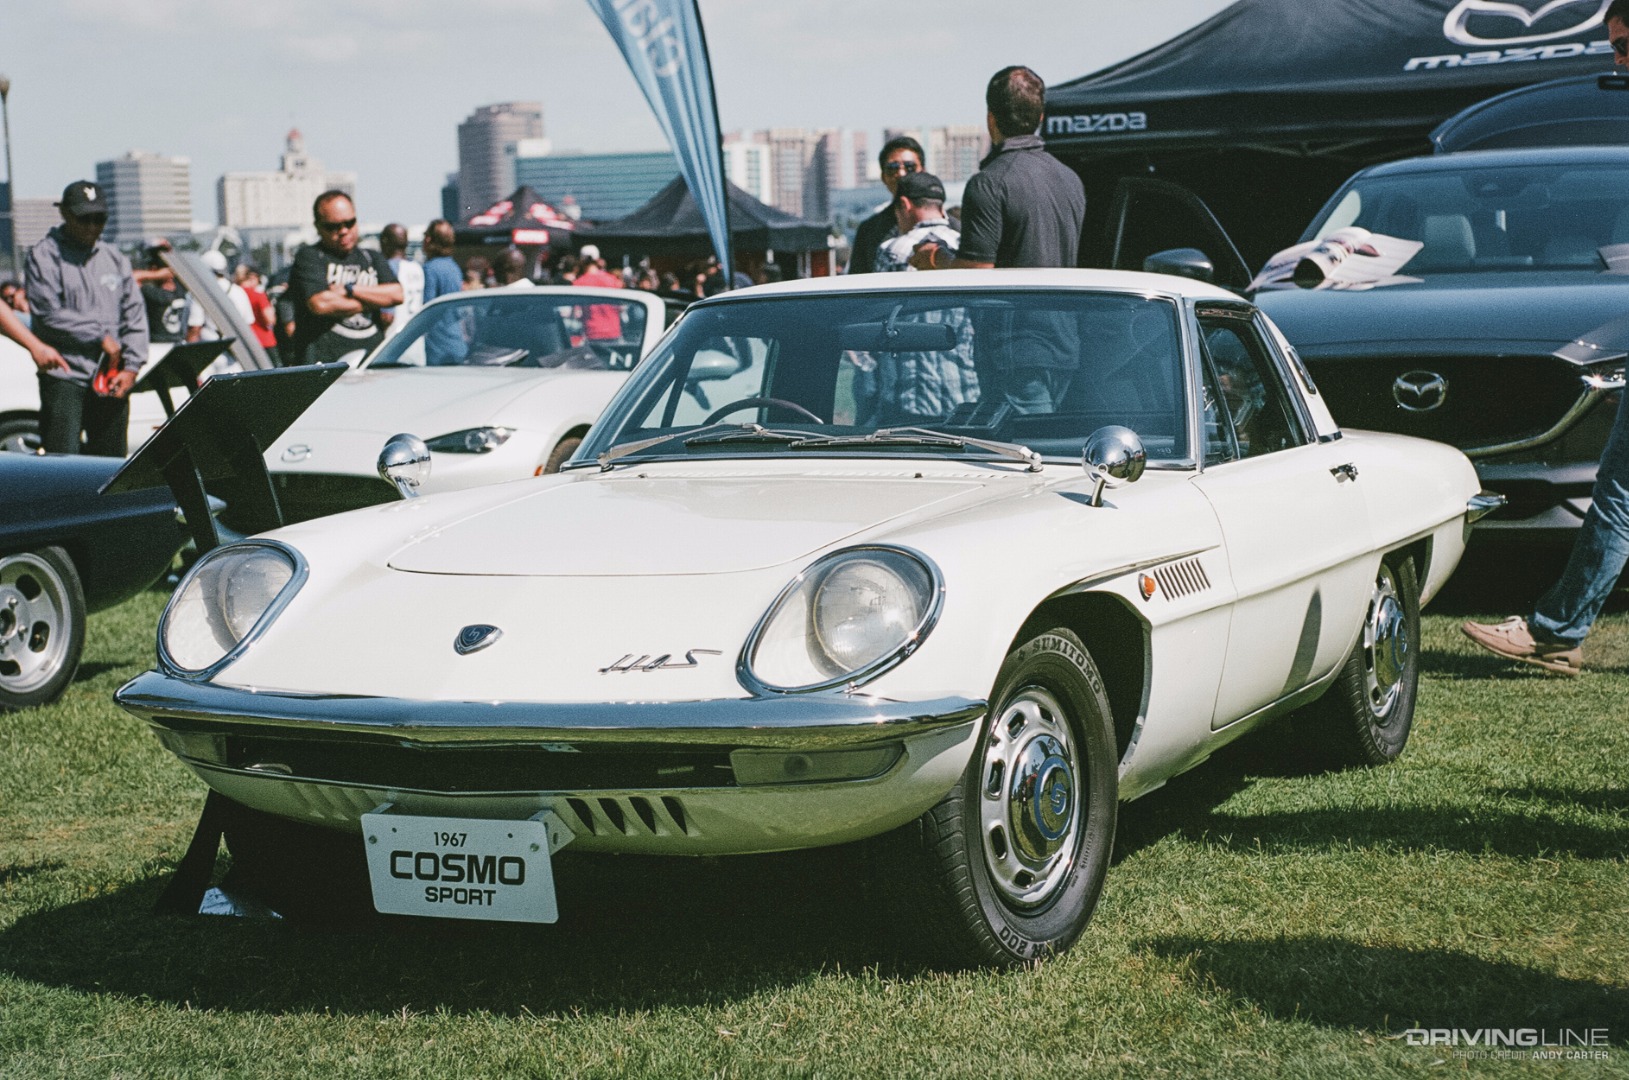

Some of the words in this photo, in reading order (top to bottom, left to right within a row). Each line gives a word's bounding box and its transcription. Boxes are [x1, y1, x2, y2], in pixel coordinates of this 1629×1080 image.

[1032, 637, 1101, 694] SUMITOMO
[433, 831, 468, 848] 1967
[389, 850, 526, 886] COSMO
[424, 886, 497, 906] SPORT
[999, 926, 1028, 955] 200
